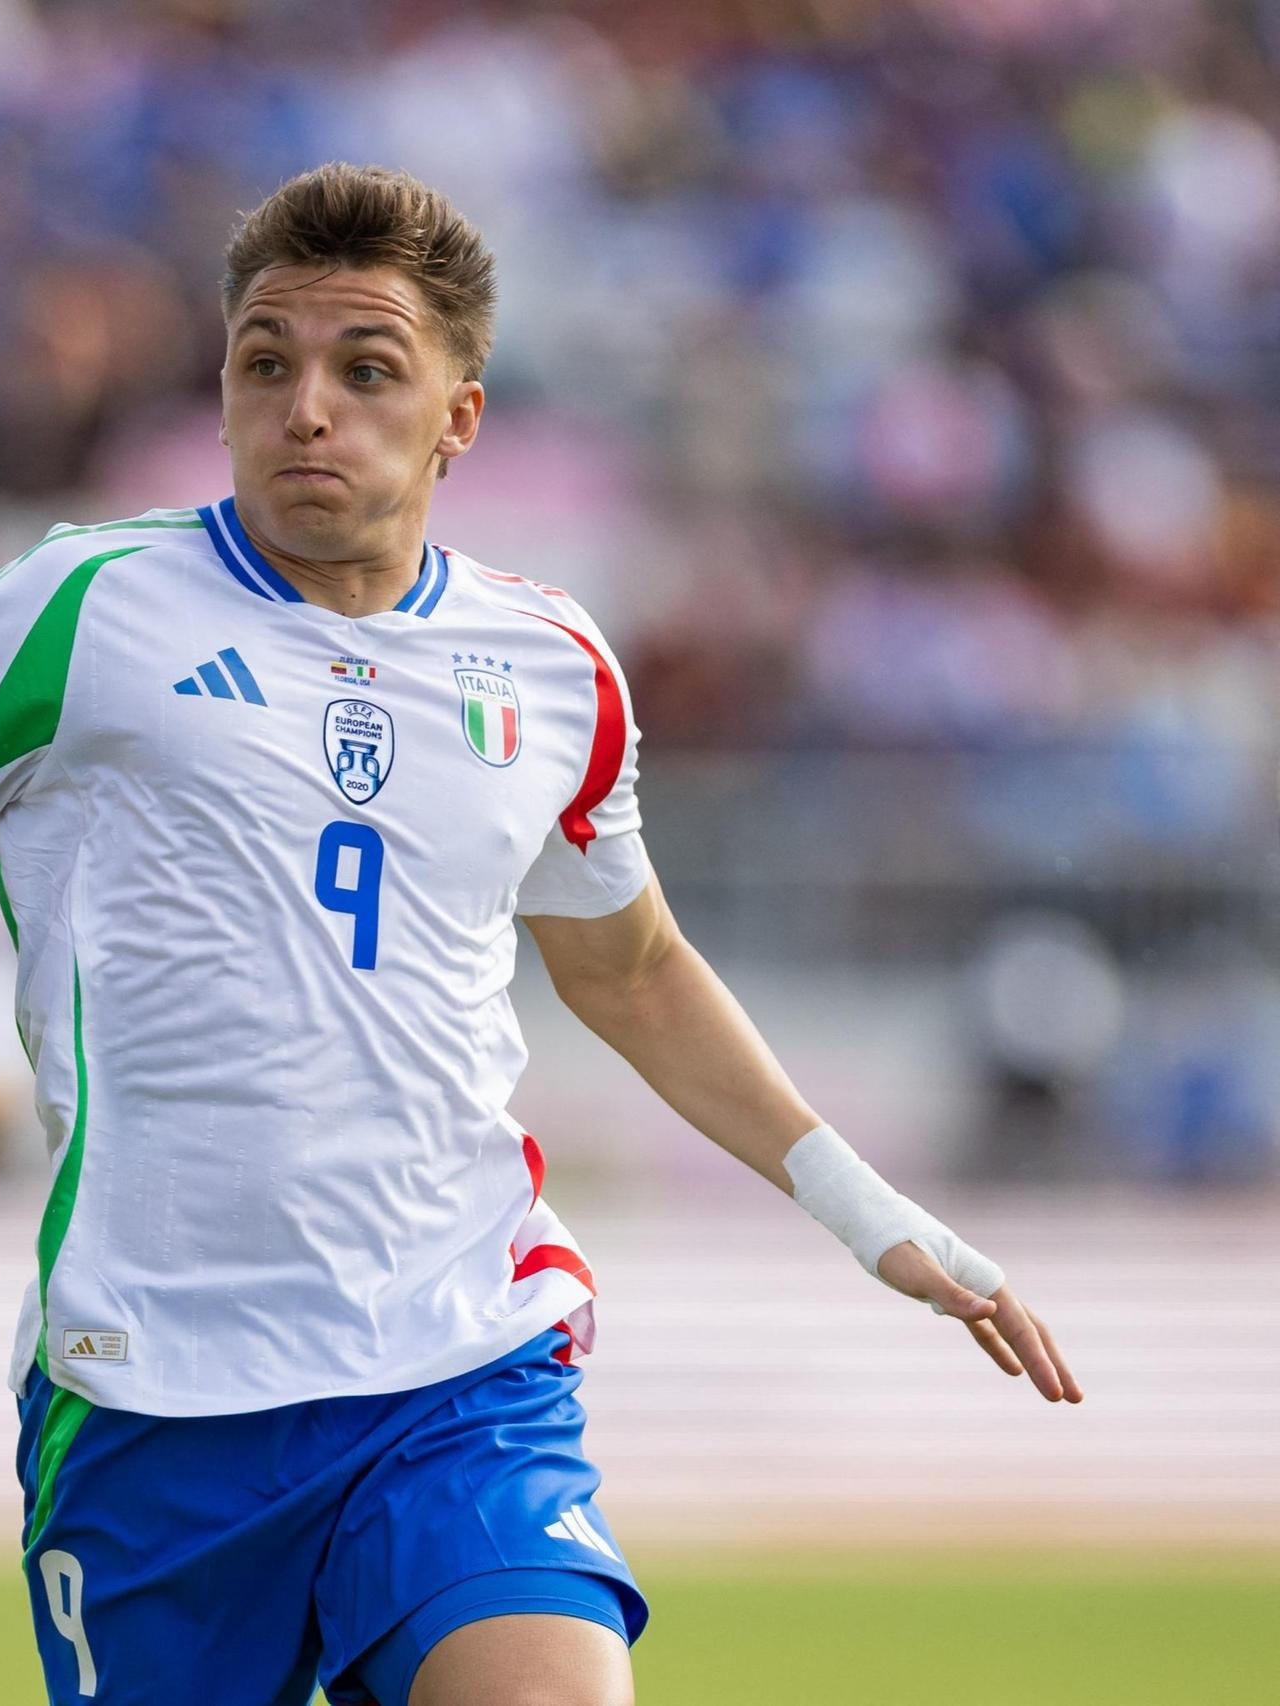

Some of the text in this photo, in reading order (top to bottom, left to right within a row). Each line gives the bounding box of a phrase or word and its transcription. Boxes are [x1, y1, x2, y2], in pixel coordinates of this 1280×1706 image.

[460, 675, 513, 699] ITALIA
[345, 704, 373, 719] UEFA
[335, 716, 383, 731] EUROPEAN
[335, 725, 383, 740] CHAMPIONS
[346, 779, 369, 792] 2020
[314, 820, 384, 971] 9
[39, 1549, 97, 1697] 9
